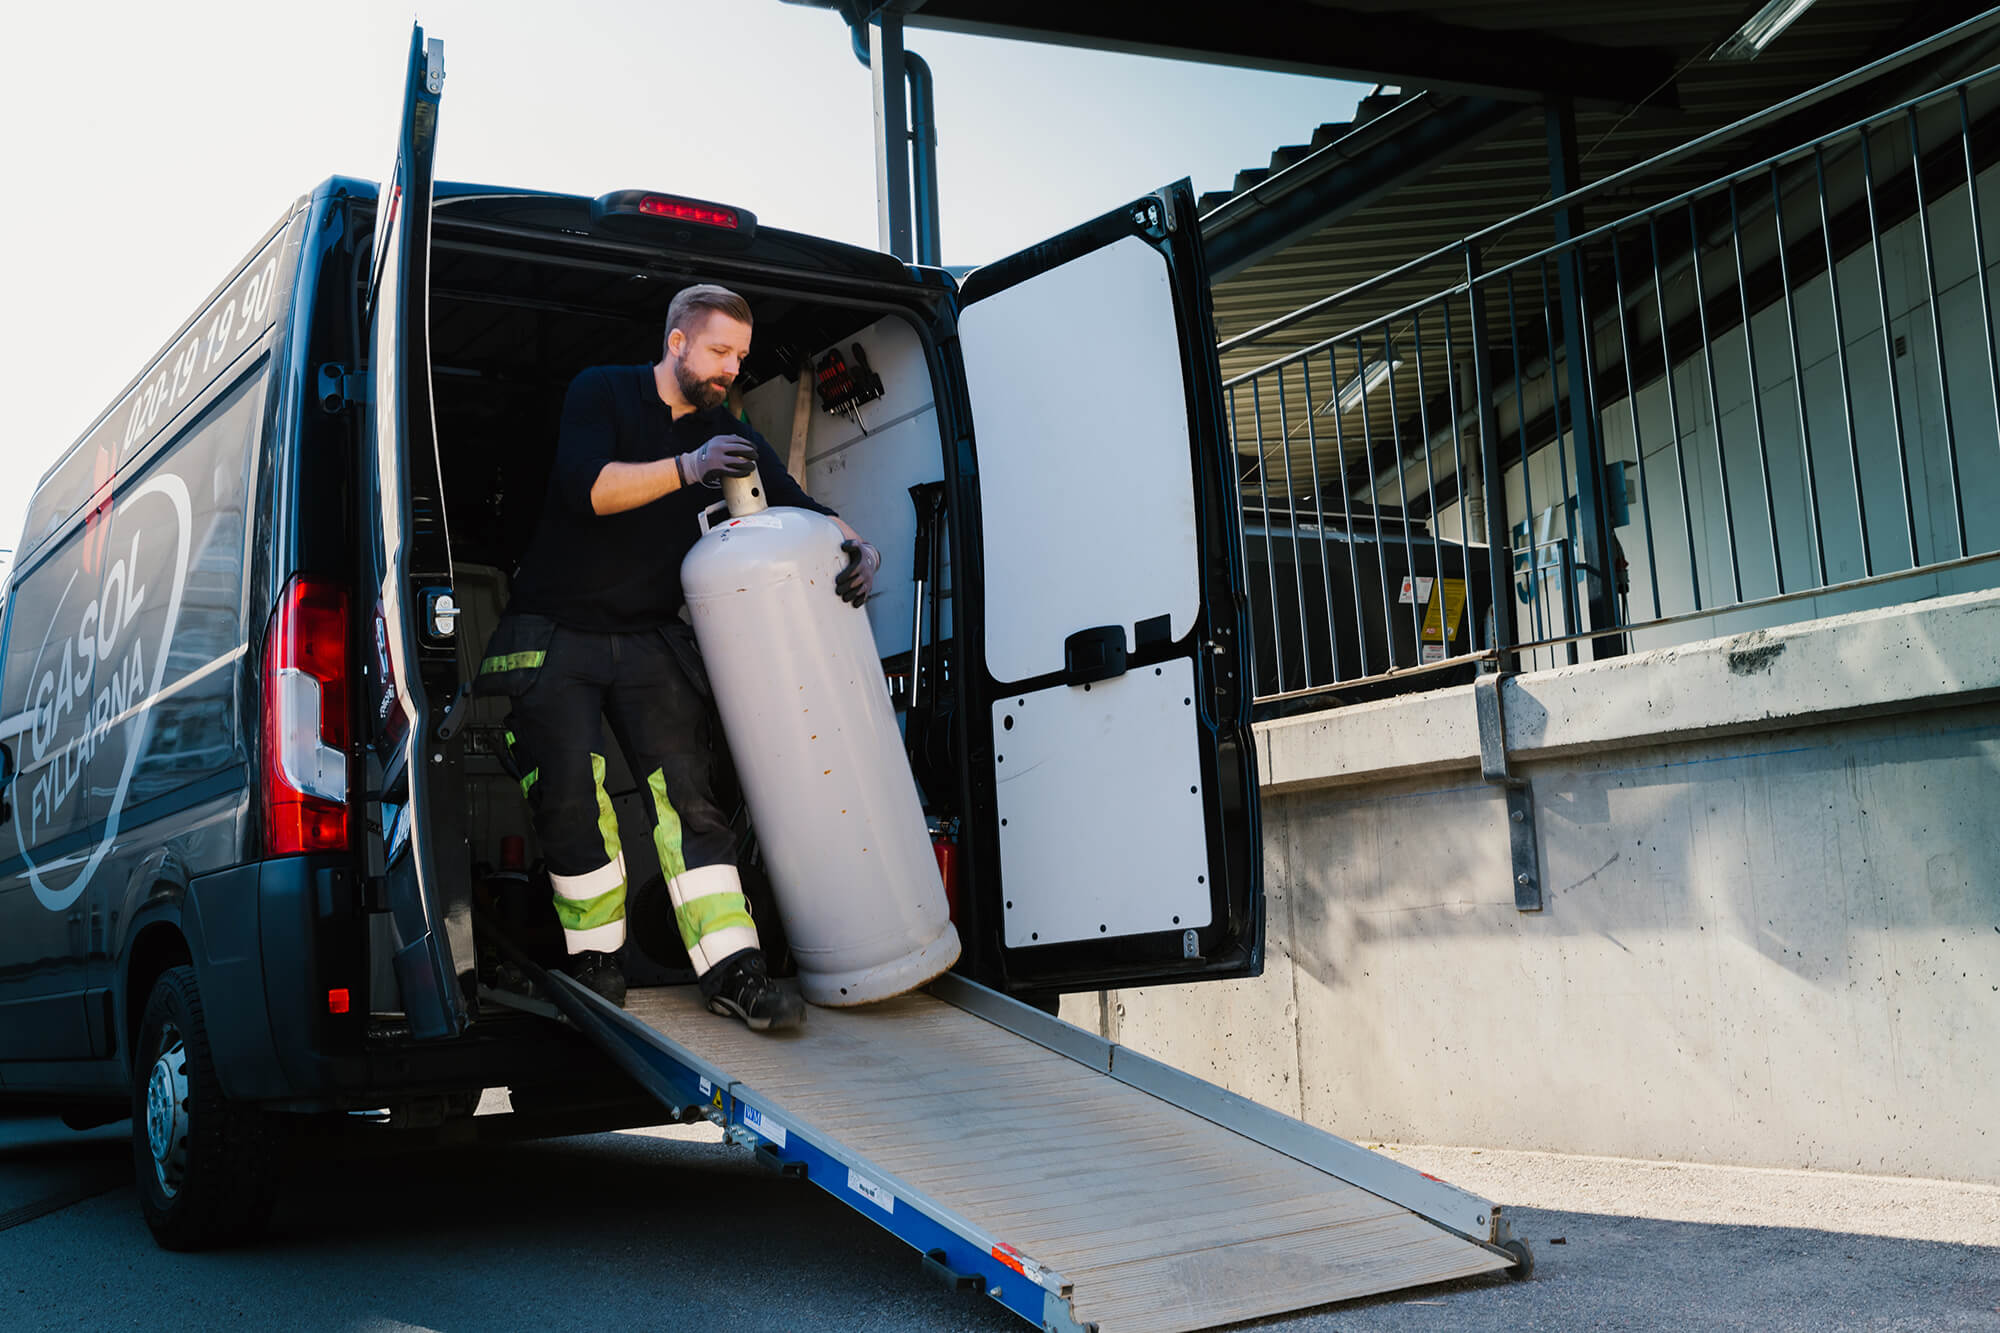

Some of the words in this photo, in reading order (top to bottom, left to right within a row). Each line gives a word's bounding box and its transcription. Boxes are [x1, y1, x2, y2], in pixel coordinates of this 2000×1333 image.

[124, 337, 199, 450] 020-19
[203, 299, 235, 374] 19
[236, 257, 277, 341] 90
[31, 637, 146, 846] FYLLARNA
[32, 529, 146, 761] GASOL
